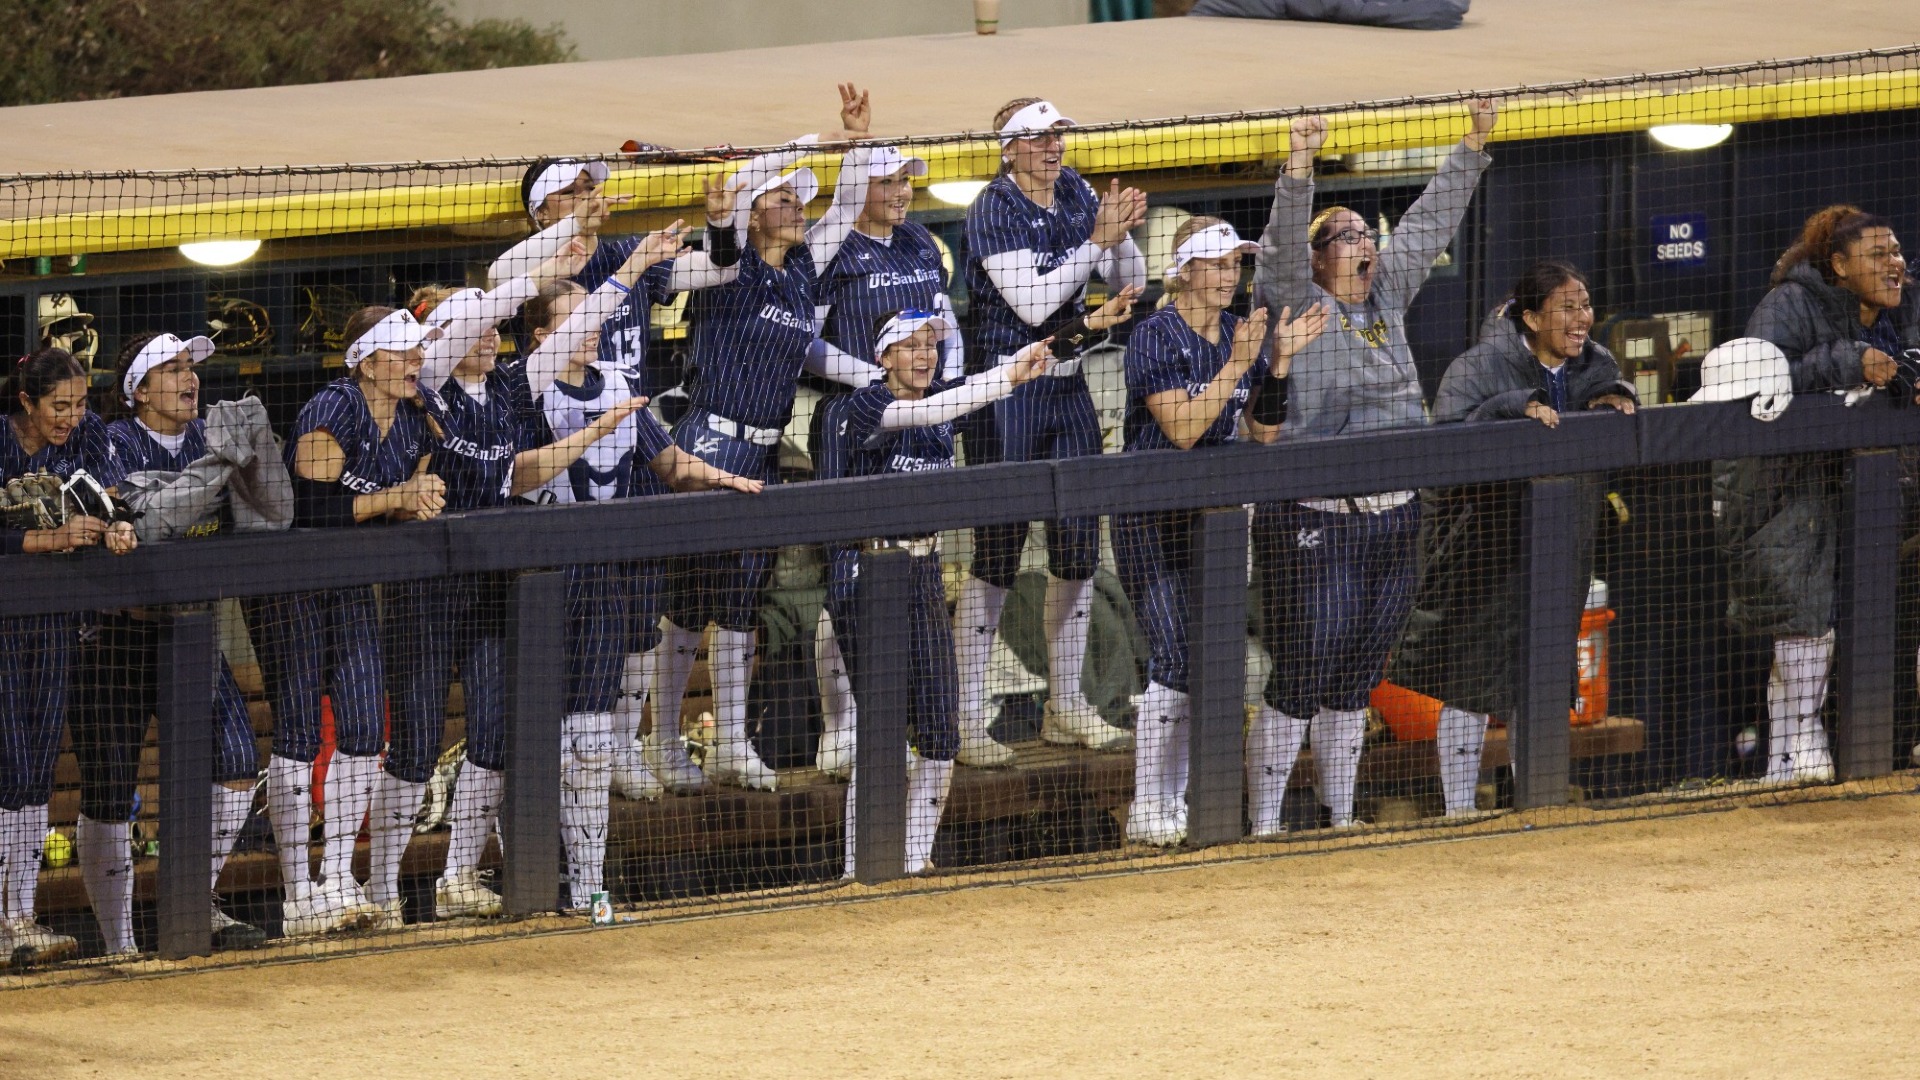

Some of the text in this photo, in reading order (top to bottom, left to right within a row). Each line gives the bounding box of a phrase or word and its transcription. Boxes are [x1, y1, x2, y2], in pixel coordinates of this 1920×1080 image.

[1669, 223, 1690, 240] NO
[1657, 241, 1703, 261] SEEDS
[611, 326, 641, 367] 13
